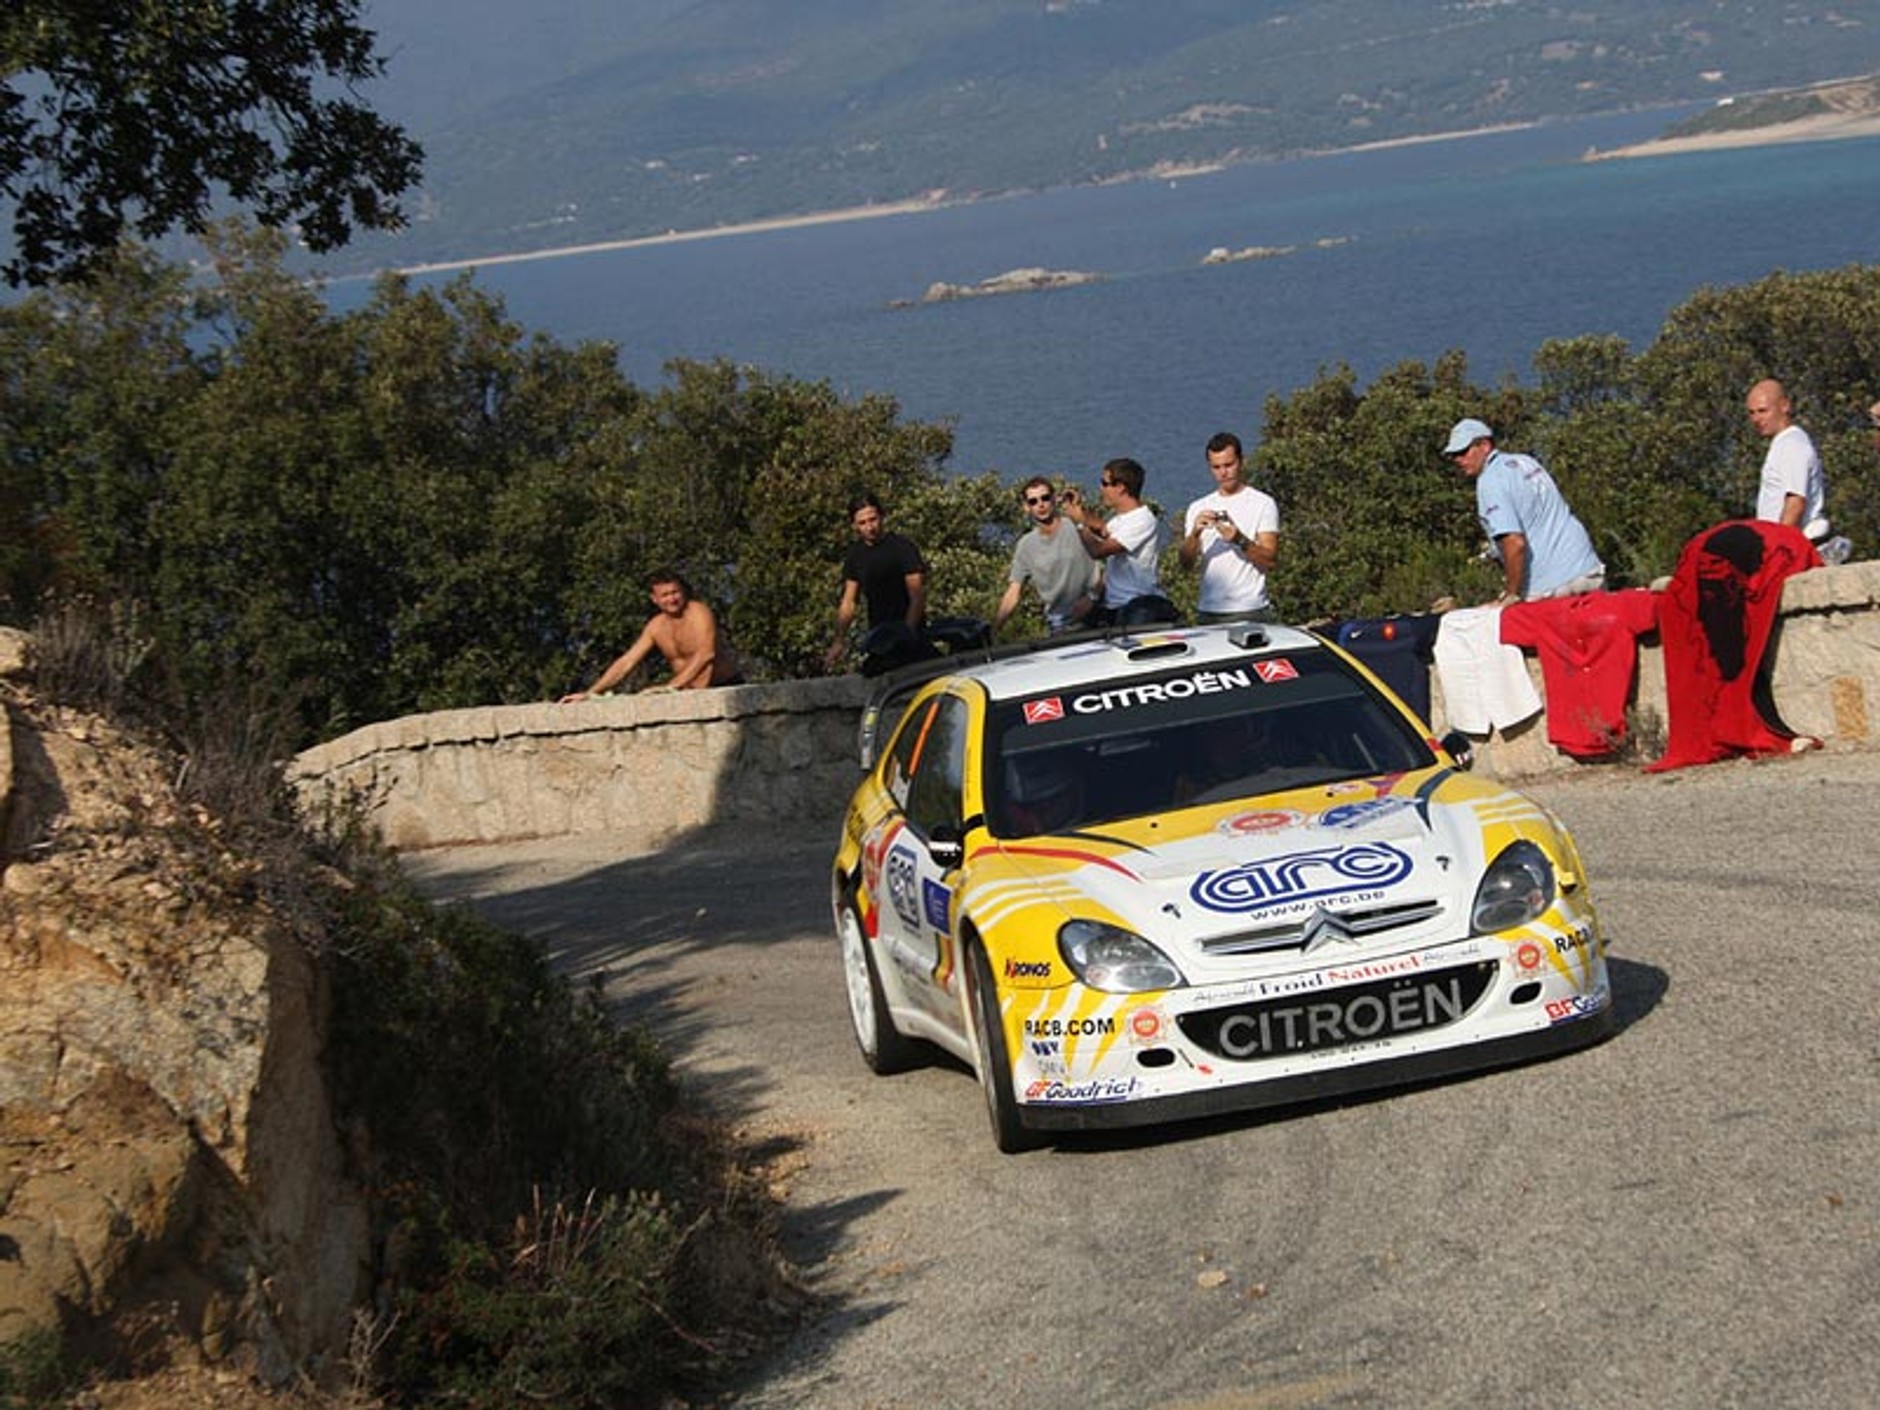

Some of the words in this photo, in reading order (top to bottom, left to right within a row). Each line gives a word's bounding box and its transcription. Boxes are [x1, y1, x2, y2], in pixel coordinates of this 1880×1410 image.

[1072, 669, 1251, 713] CITROËN
[1190, 842, 1413, 913] arc
[1250, 890, 1386, 920] www.arc.be
[1025, 1017, 1115, 1037] RACB.COM
[1218, 978, 1464, 1057] CITROËN
